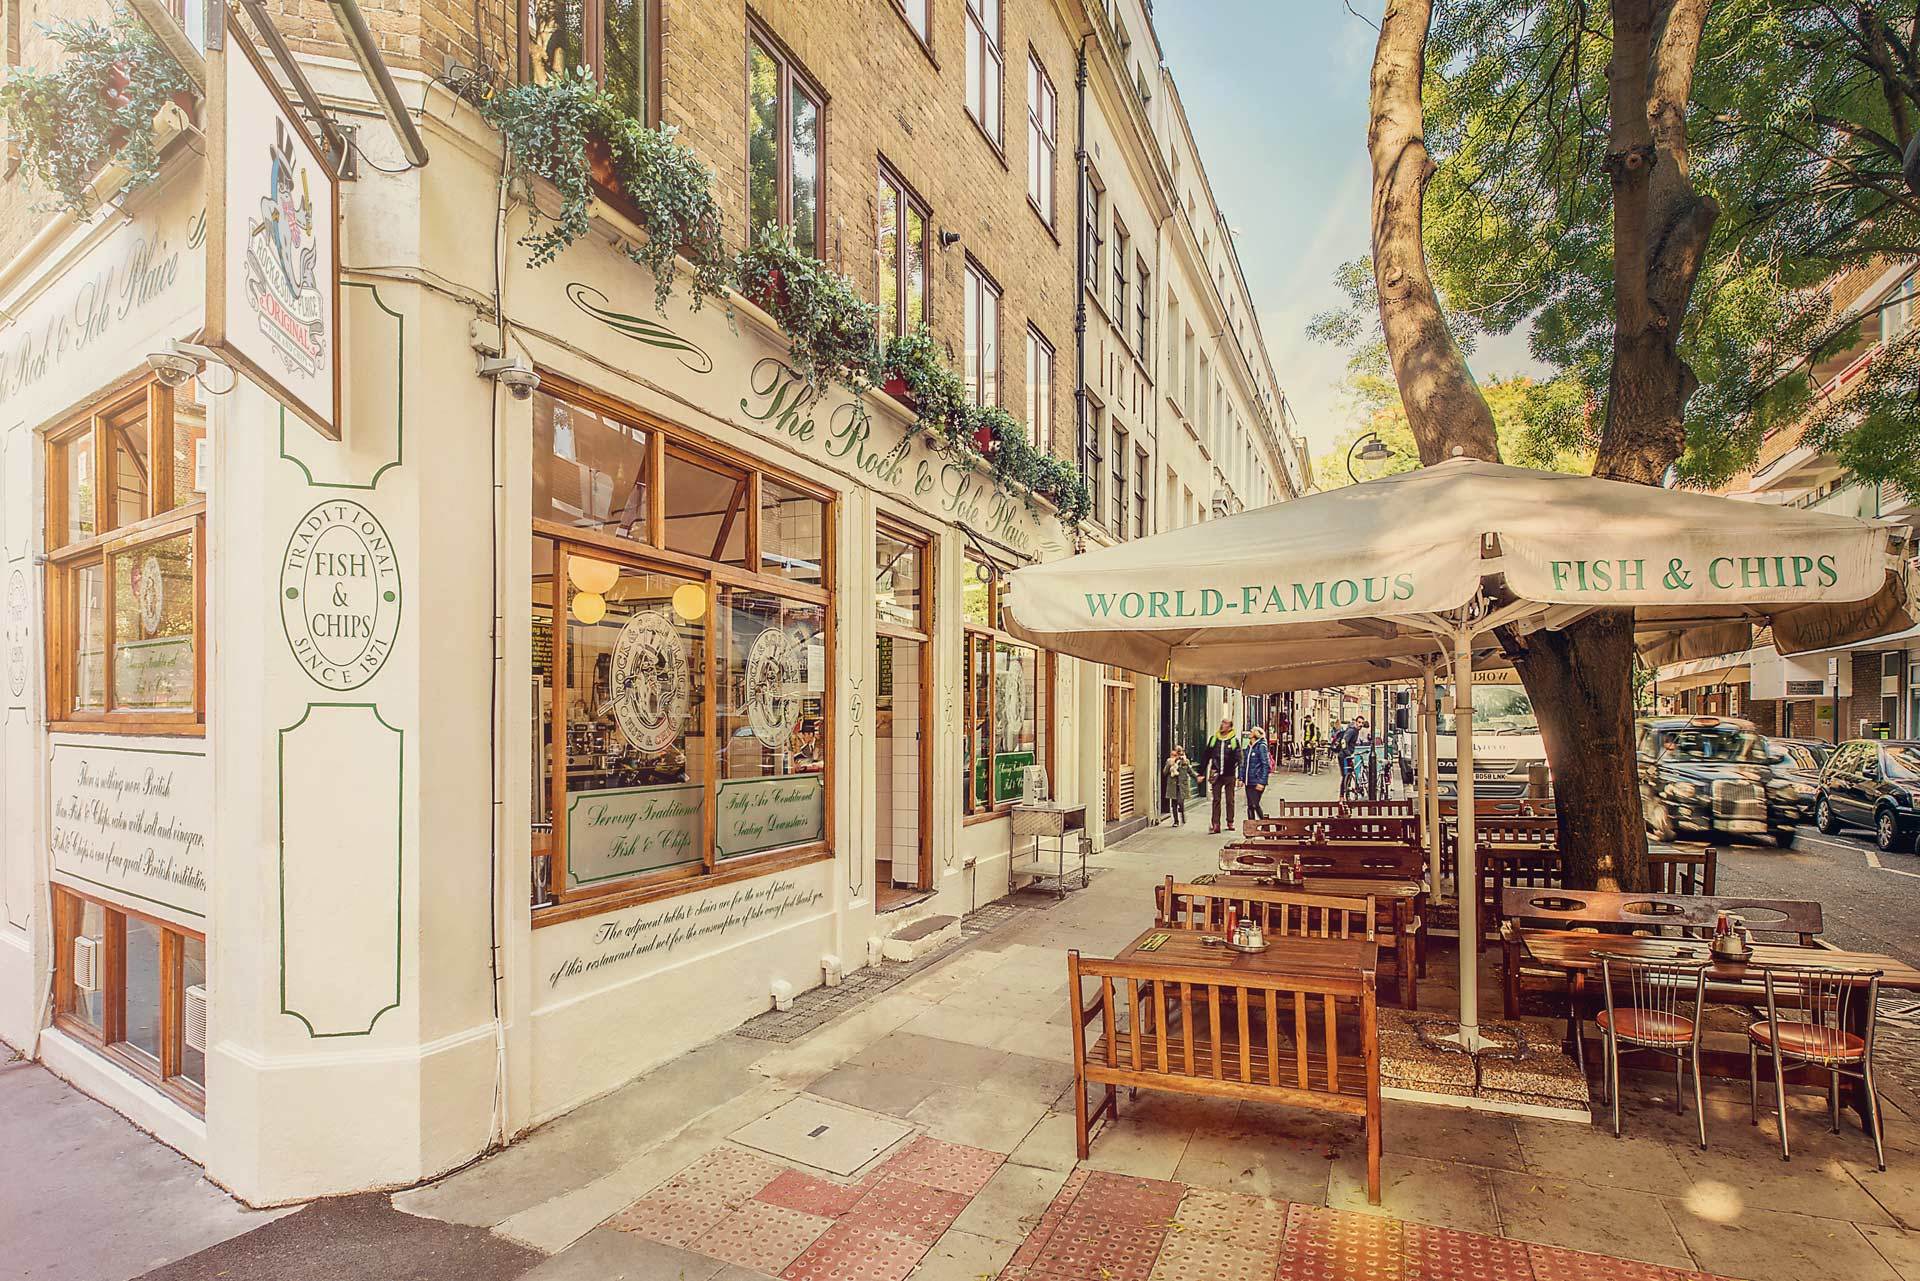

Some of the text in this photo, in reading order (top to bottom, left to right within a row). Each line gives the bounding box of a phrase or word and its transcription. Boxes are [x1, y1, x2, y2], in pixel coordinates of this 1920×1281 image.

[118, 231, 178, 321] Plaice
[256, 237, 277, 281] ROCK
[266, 293, 310, 350] ORIGINAL
[740, 357, 1030, 549] The Rock & Sole Plaice
[287, 506, 394, 578] TRADITIONAL
[315, 552, 367, 578] FISH
[1549, 554, 1840, 592] FISH & CHIPS
[332, 581, 348, 607] &
[1084, 573, 1416, 619] WORLD-FAMOUS
[312, 613, 371, 638] CHIPS
[294, 637, 388, 684] SINCE 1871
[615, 642, 632, 695] ROCK
[142, 766, 174, 798] British
[725, 786, 816, 812] Fully Air Conditioned
[128, 809, 145, 833] with
[143, 812, 159, 838] salt
[158, 816, 175, 841] and
[587, 799, 703, 829] Serving Traditional
[732, 813, 810, 838] Seating Downstairs
[607, 829, 692, 859] Fish & Chips
[142, 848, 174, 882] British
[594, 920, 622, 944] The
[624, 913, 663, 940] adjacent
[664, 905, 685, 925] tables
[694, 899, 717, 916] chairs
[718, 901, 730, 911] are
[730, 890, 743, 911] for
[744, 887, 754, 901] the
[549, 960, 568, 989] of
[565, 956, 583, 977] this
[585, 943, 637, 972] restaurant
[636, 934, 658, 955] and
[655, 932, 672, 951] not
[669, 927, 683, 951] for
[685, 922, 697, 940] the
[698, 913, 741, 935] consumption
[740, 906, 753, 927] of
[751, 904, 764, 919] take
[780, 894, 798, 914] food
